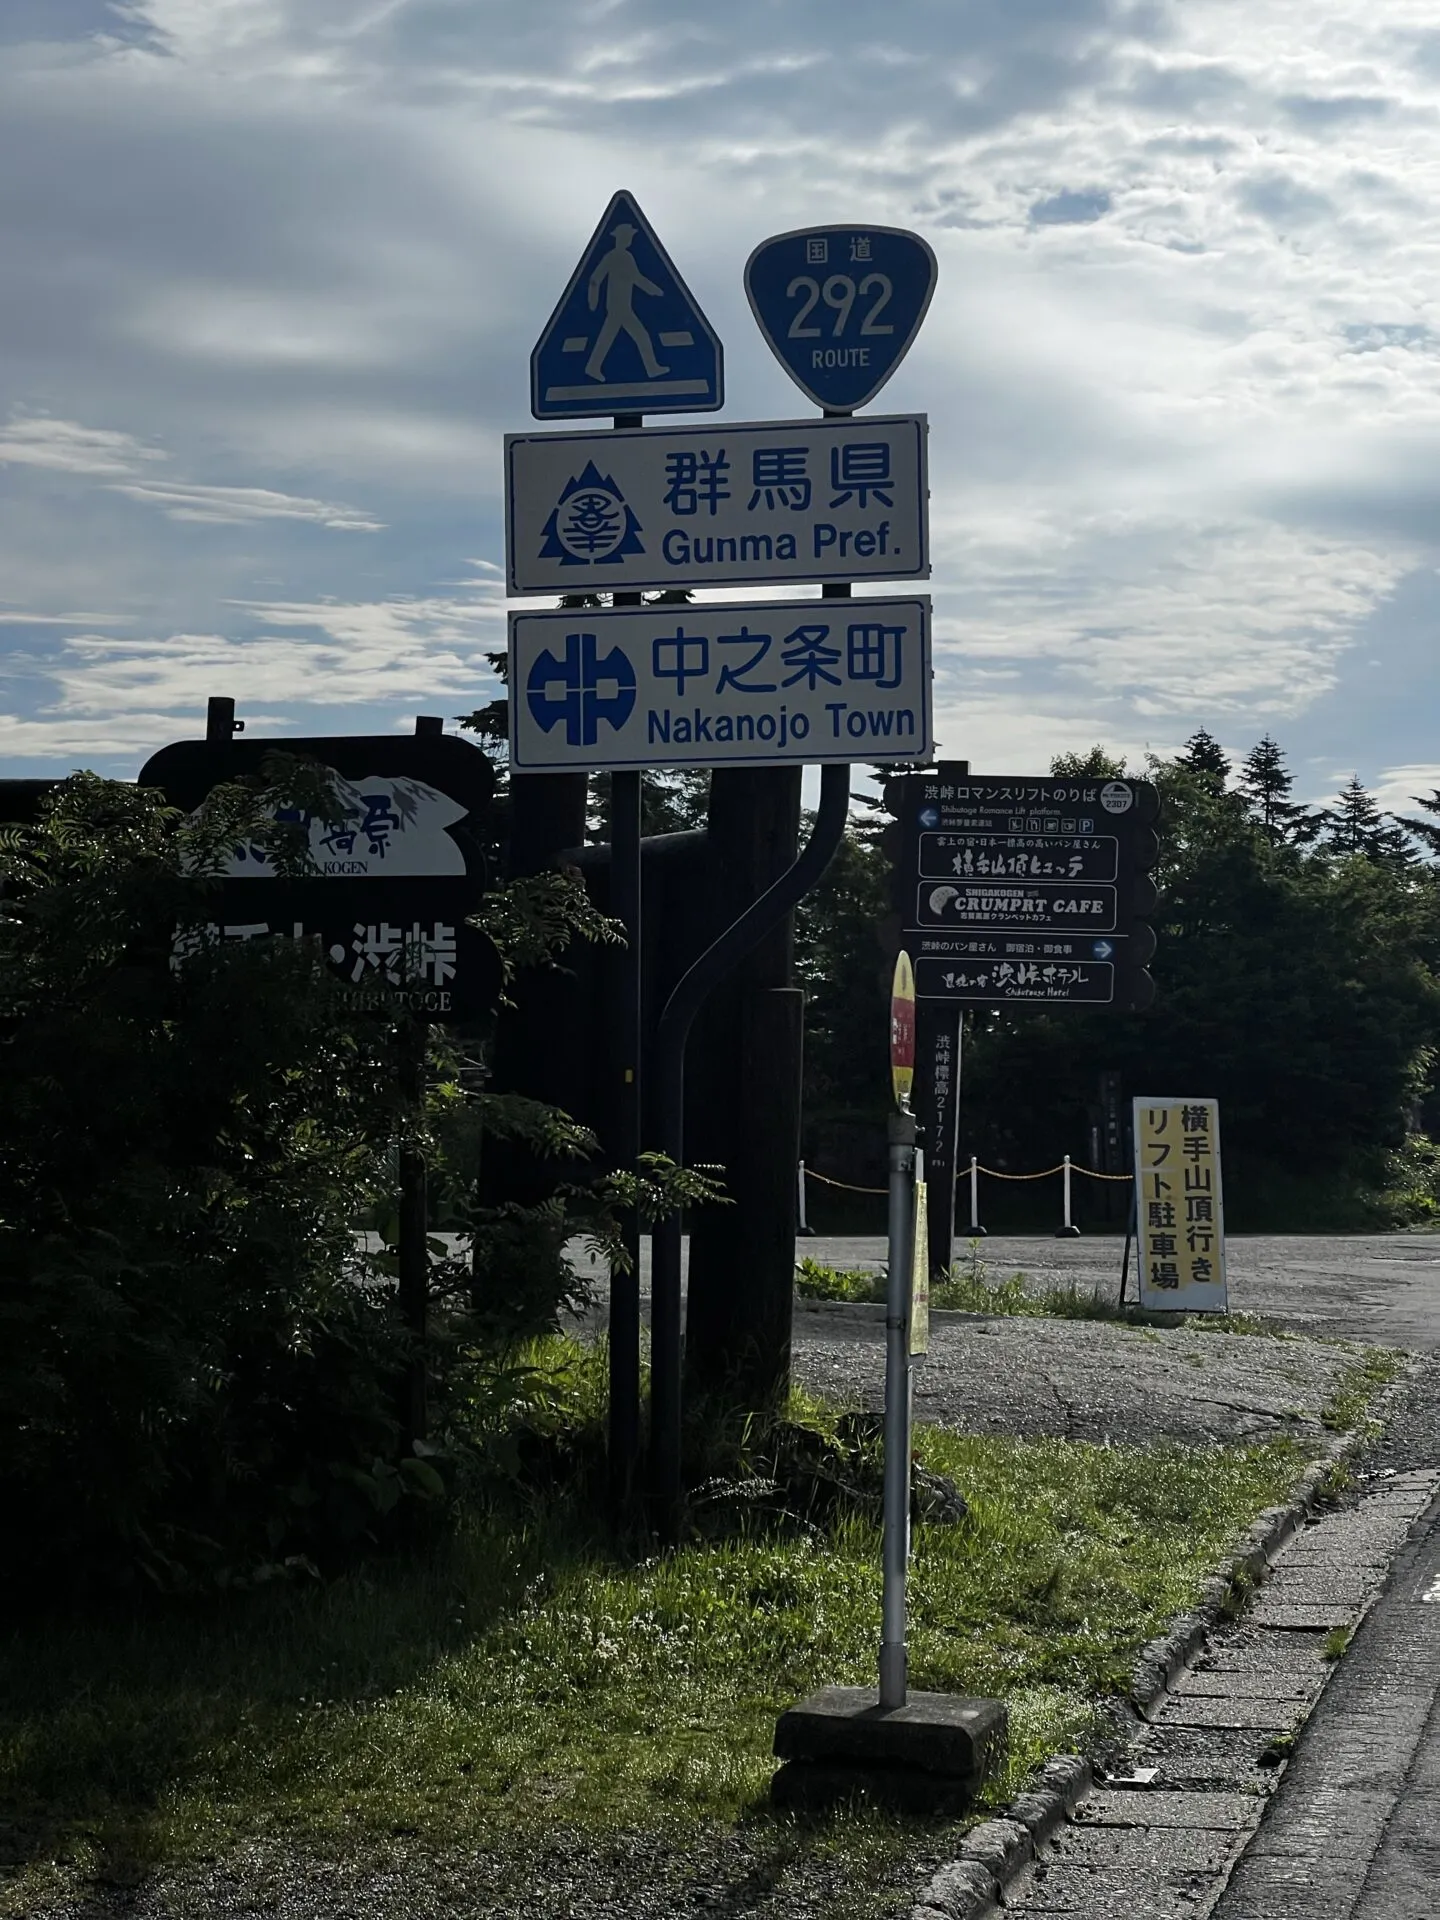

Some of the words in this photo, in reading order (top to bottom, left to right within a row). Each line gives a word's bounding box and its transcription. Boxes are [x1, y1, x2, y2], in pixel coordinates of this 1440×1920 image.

[806, 237, 873, 264] 国道
[785, 272, 894, 339] 292
[812, 348, 871, 369] ROUTE
[663, 442, 895, 516] 群馬県
[662, 529, 797, 566] Gunma
[813, 521, 901, 558] Pref.
[653, 622, 907, 697] 中之条町
[647, 706, 810, 748] Nakanojo
[825, 703, 915, 738] Town
[924, 784, 1098, 803] 渋峠ロマンスリフトのりば
[324, 861, 368, 874] KOGEN
[965, 888, 1025, 897] SHIGAKOGEN
[1053, 899, 1104, 914] CAFE
[1148, 1108, 1179, 1290] リフト駐車場
[1181, 1105, 1214, 1282] 横手山頂行き
